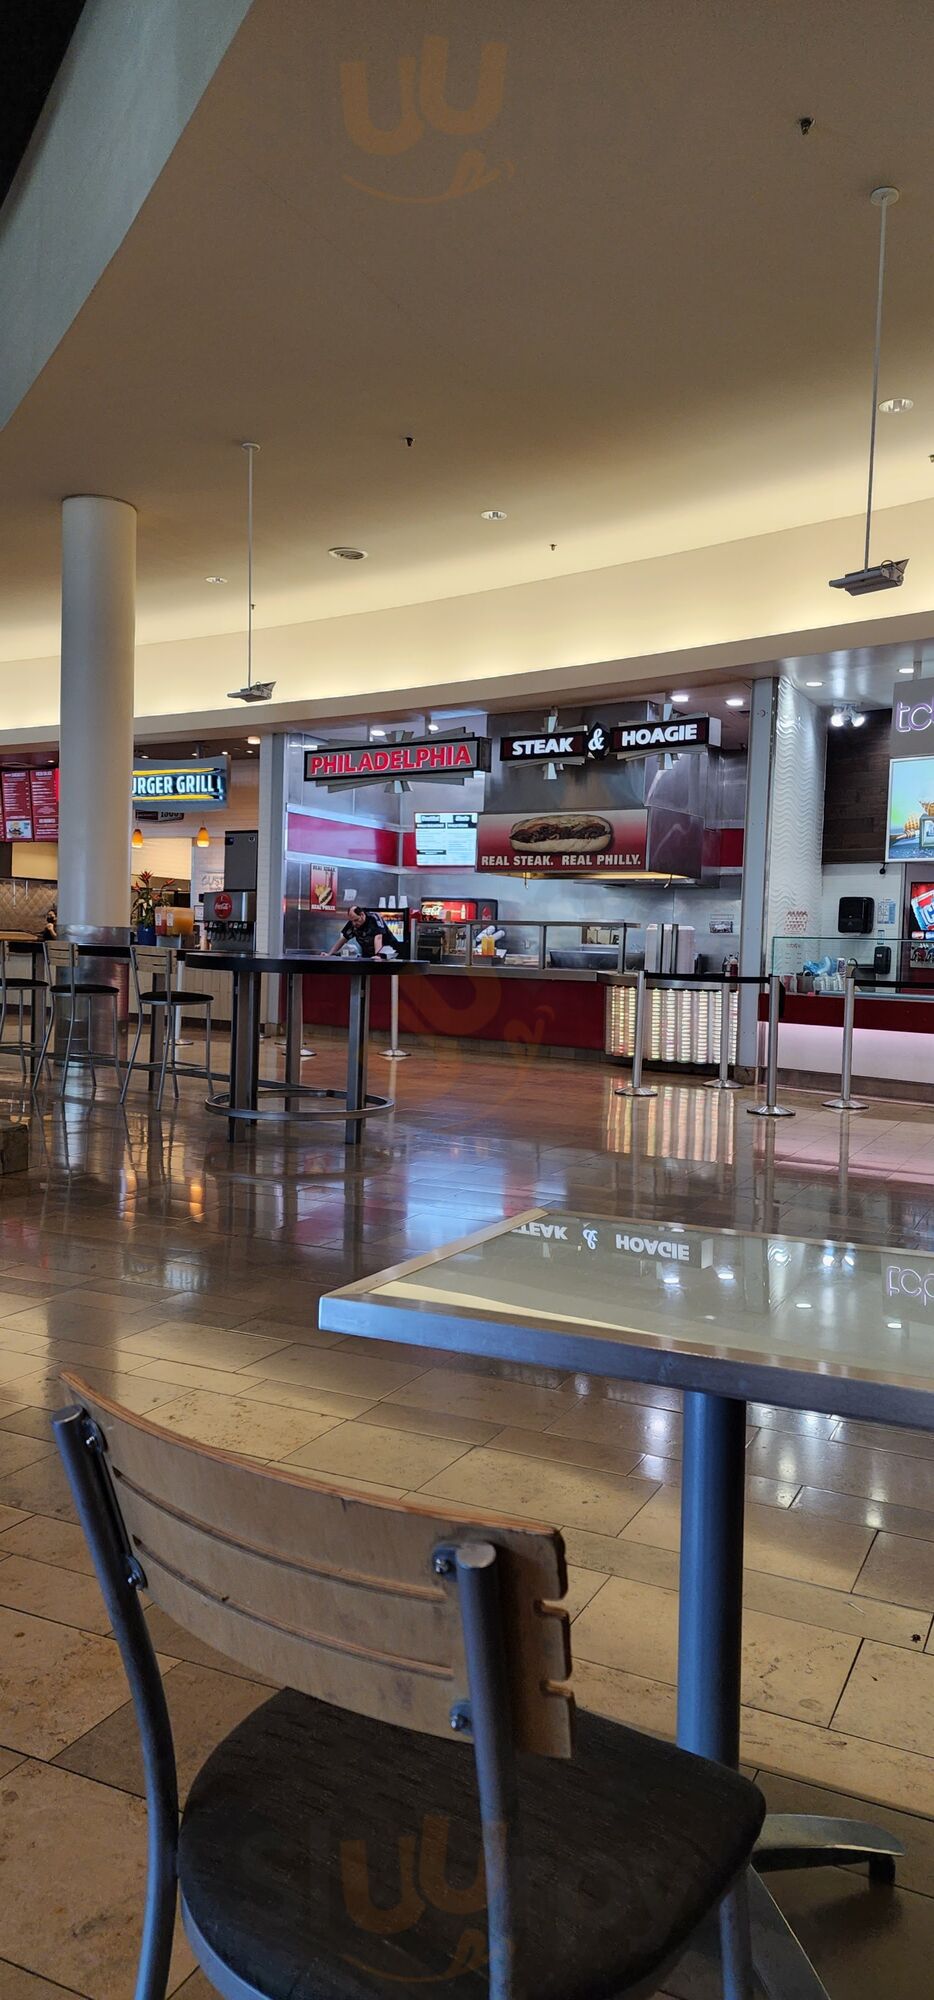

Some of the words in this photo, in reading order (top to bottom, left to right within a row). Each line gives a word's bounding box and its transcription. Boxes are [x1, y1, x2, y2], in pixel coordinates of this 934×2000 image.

[896, 700, 934, 733] tc
[512, 736, 574, 756] STEAK
[588, 728, 605, 751] &
[622, 724, 698, 747] HOAGIE
[311, 744, 473, 775] PHILADELPHIA
[132, 776, 173, 794] URGER
[176, 775, 214, 793] GRILL
[481, 855, 510, 866] REAL
[513, 854, 554, 867] STEAK.
[561, 854, 593, 866] REAL
[597, 853, 642, 866] PHILLY.
